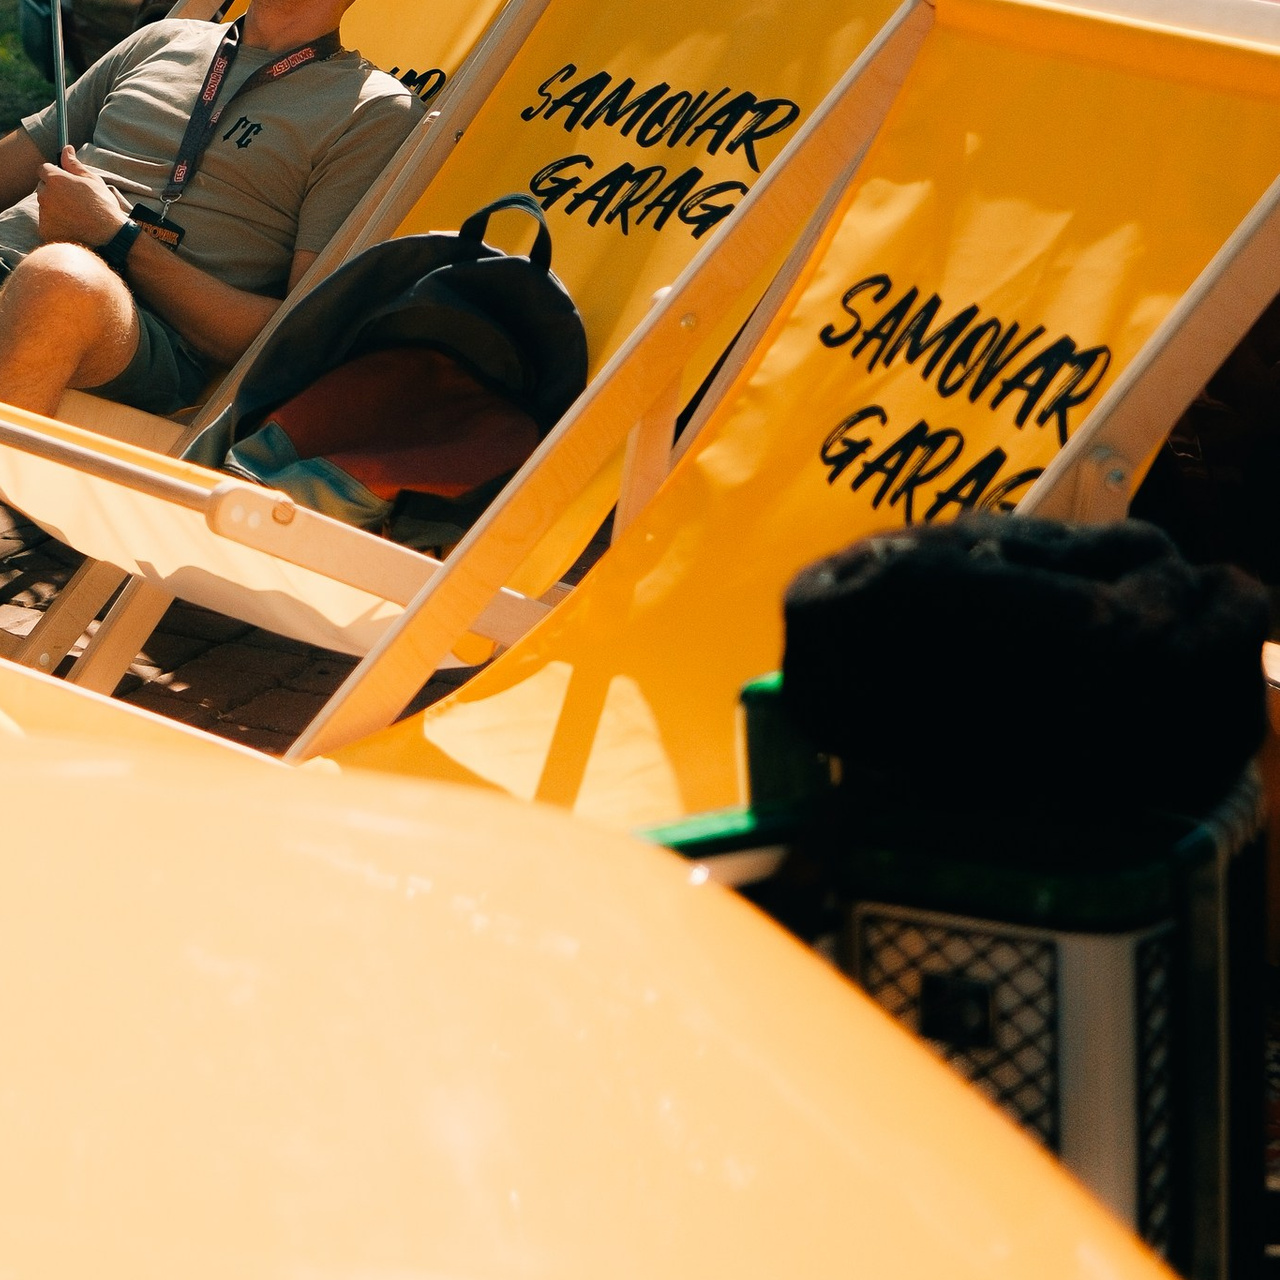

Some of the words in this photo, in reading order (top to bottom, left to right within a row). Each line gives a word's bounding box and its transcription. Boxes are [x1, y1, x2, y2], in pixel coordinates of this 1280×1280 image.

[520, 63, 800, 173] SAMOVAR
[529, 154, 750, 240] GARAG
[819, 273, 1112, 450] SAMOVAR
